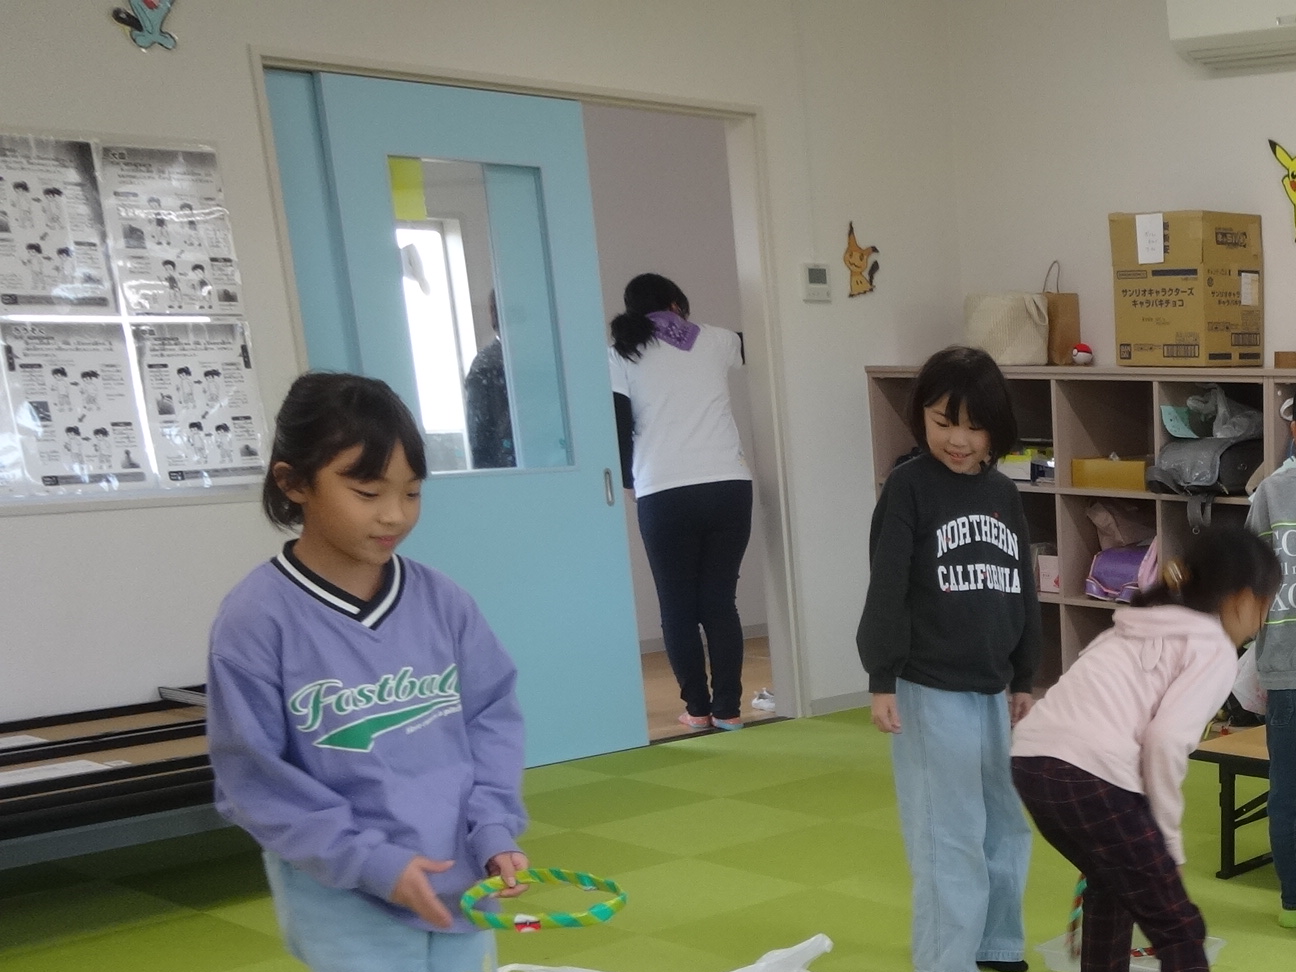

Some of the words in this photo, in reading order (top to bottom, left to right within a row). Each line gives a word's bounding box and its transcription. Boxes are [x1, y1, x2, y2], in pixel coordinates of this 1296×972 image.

[1121, 287, 1195, 297] サンリオキャラクターズ
[937, 515, 1019, 560] NORTHERN
[938, 564, 1021, 593] CALIFORNIA
